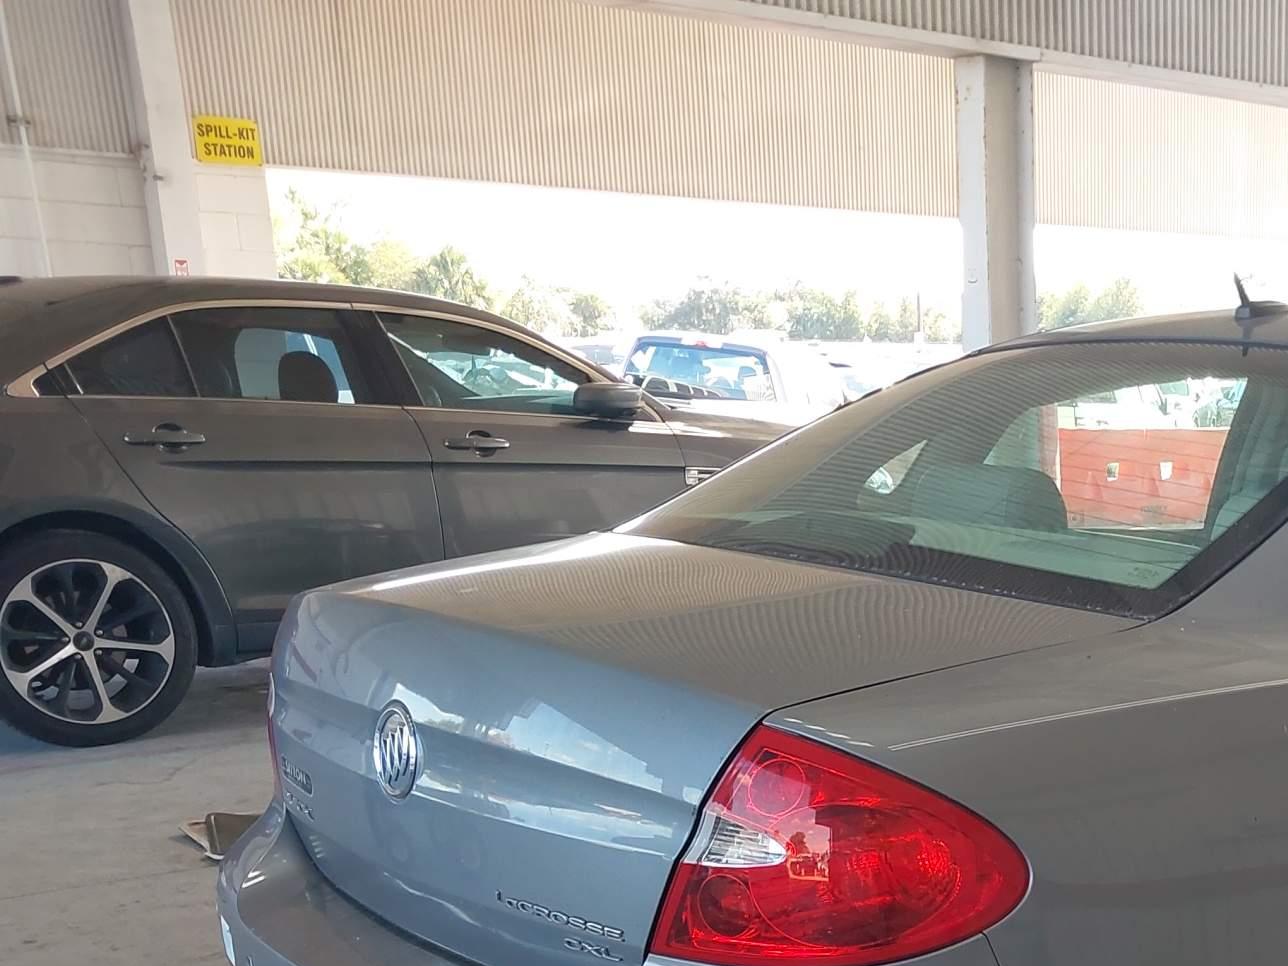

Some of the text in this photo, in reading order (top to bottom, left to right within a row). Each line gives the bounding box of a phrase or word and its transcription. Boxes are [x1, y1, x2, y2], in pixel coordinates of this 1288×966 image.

[196, 123, 256, 141] SPILL-KIT
[203, 142, 255, 160] STATION
[563, 937, 624, 962] CXL
